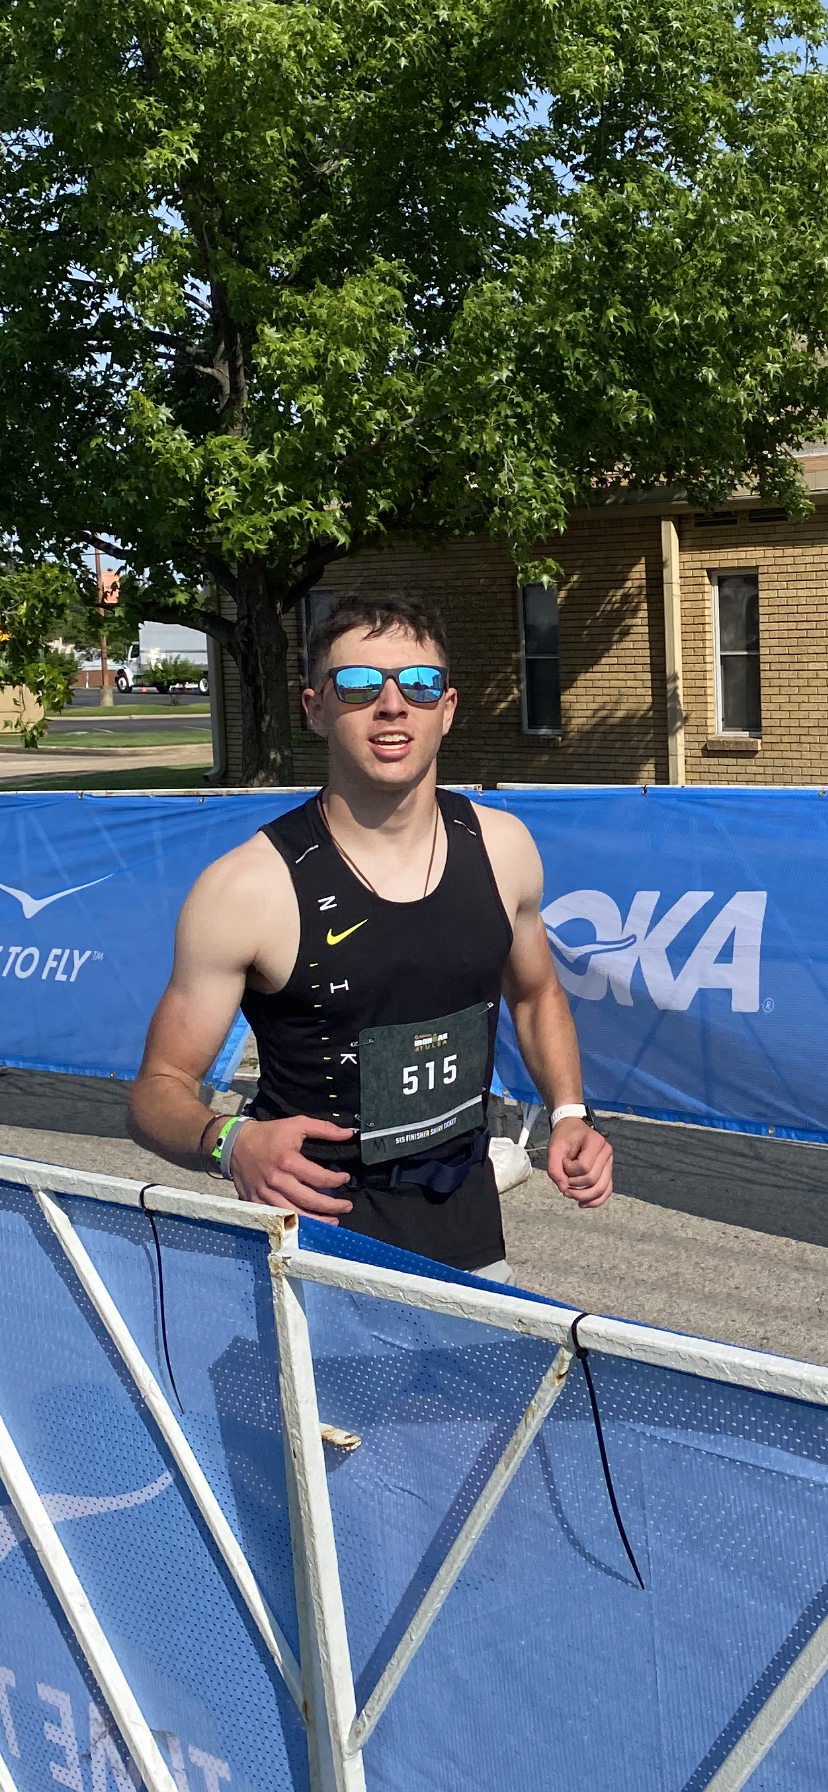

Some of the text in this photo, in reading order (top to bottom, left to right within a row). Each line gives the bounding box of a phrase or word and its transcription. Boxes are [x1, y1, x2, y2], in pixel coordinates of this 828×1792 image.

[2, 946, 40, 979] TO
[402, 1054, 458, 1095] 515
[405, 1130, 430, 1142] FINISHER
